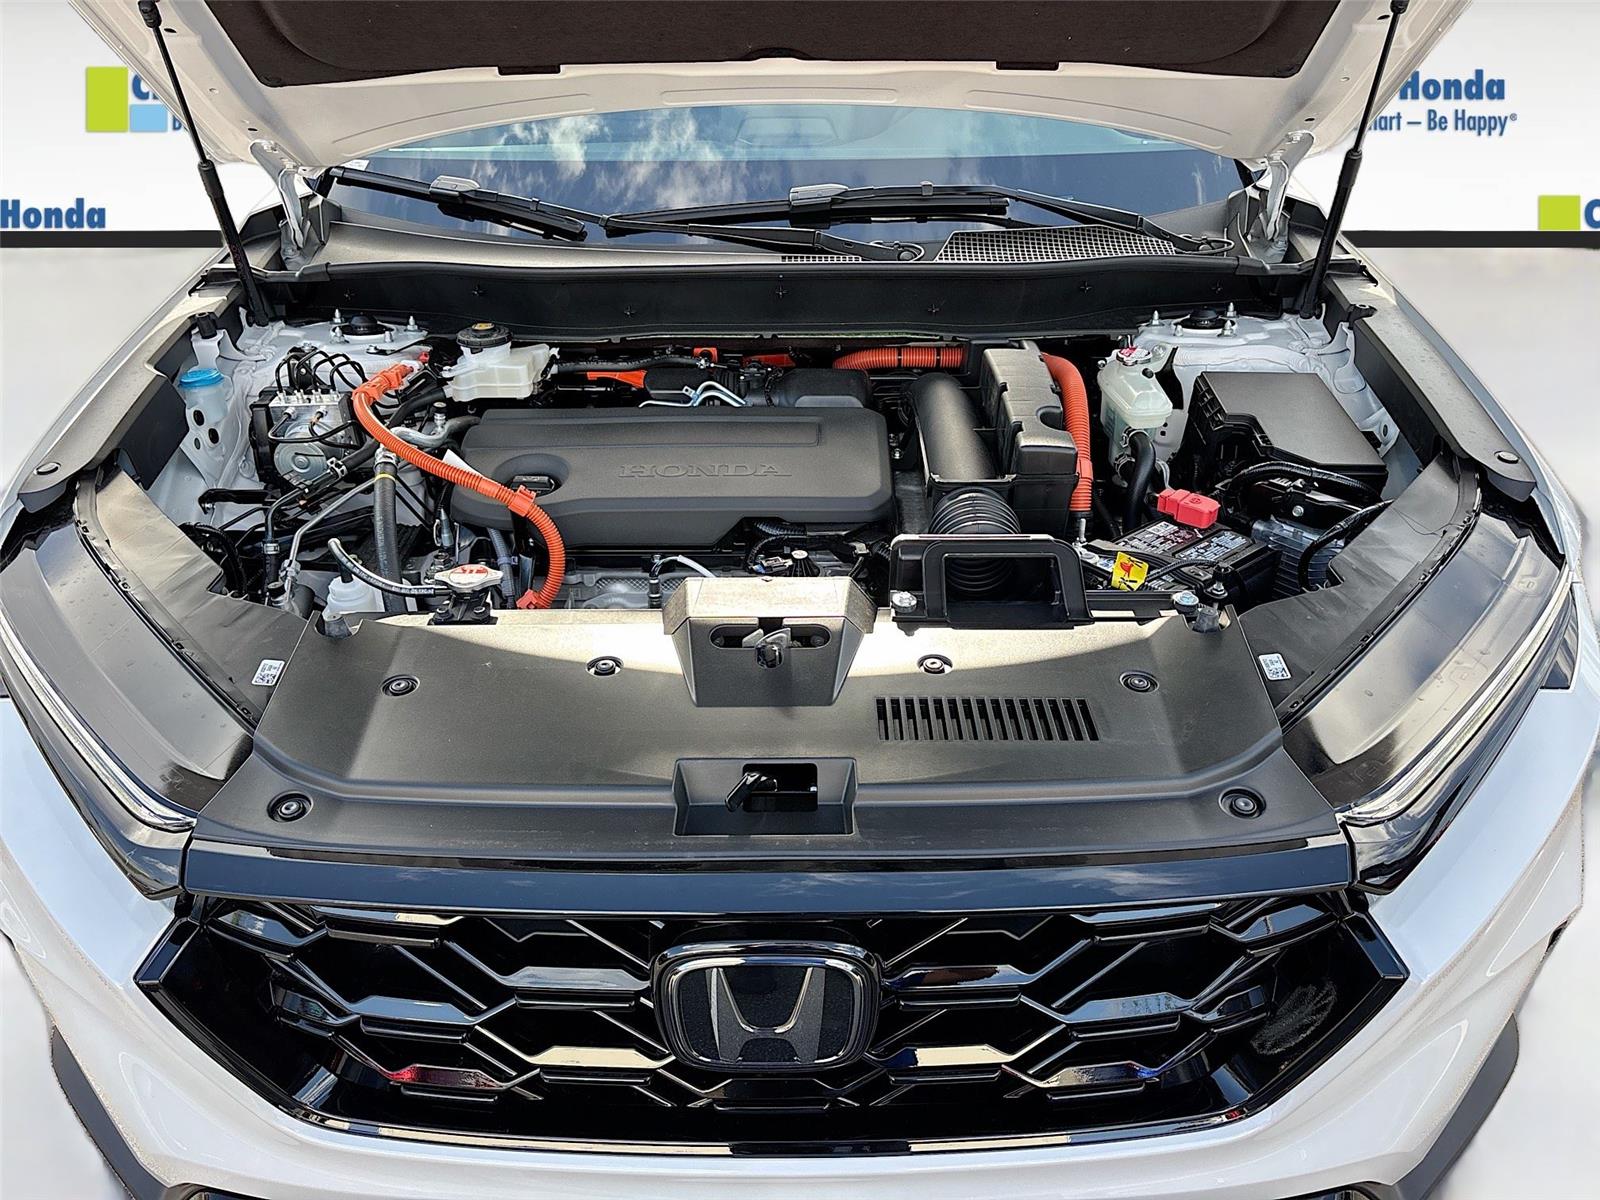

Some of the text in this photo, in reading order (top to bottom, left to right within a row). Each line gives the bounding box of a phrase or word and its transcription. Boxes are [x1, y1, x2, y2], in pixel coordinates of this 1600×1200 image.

[1399, 69, 1505, 100] Honda
[1356, 112, 1402, 131] art
[1427, 109, 1448, 131] Be
[0, 198, 106, 229] Honda
[618, 463, 793, 478] HONDA
